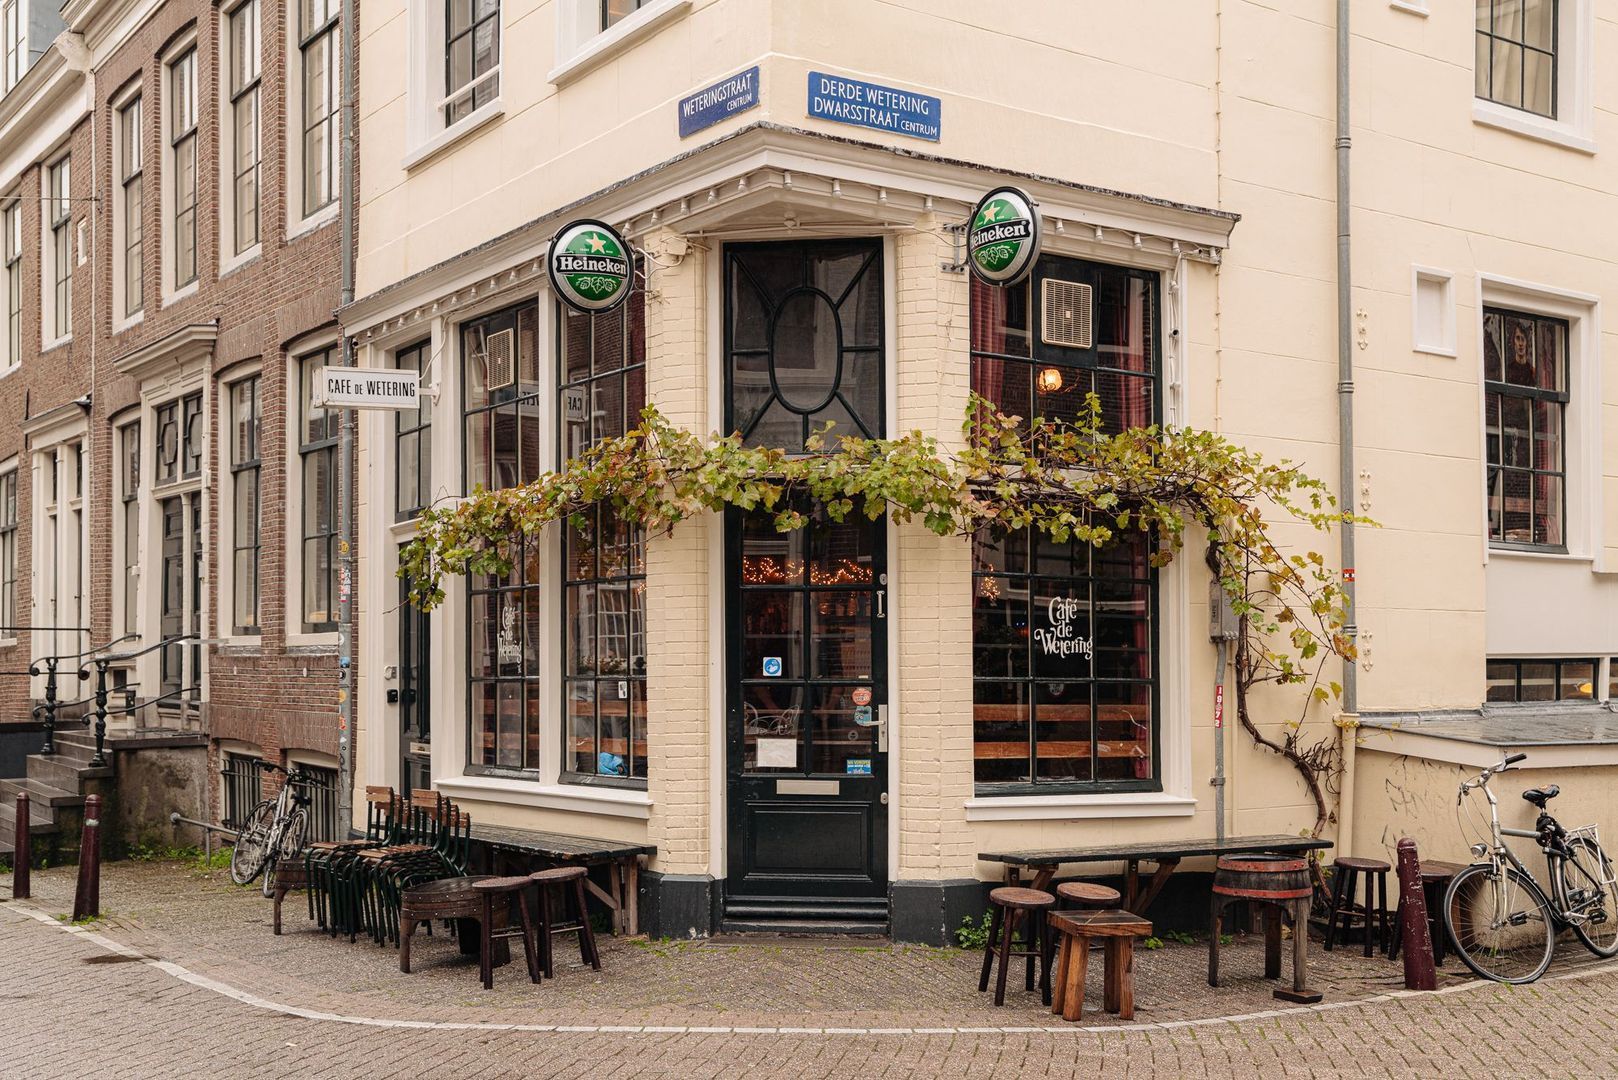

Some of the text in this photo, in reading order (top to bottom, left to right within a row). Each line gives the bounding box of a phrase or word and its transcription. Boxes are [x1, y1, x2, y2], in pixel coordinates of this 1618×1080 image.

[683, 73, 752, 117] WETERINGSTRAAT
[726, 94, 752, 112] CENTRUM
[821, 78, 929, 115] DERDE WETERING
[814, 96, 938, 137] DWARSSTRAAT CENTRUM
[560, 256, 627, 275] Heineken
[328, 378, 352, 395] CAFE
[366, 380, 415, 397] WETERING
[1048, 596, 1078, 626] Café
[1034, 627, 1094, 660] Wetering
[1057, 620, 1073, 638] de
